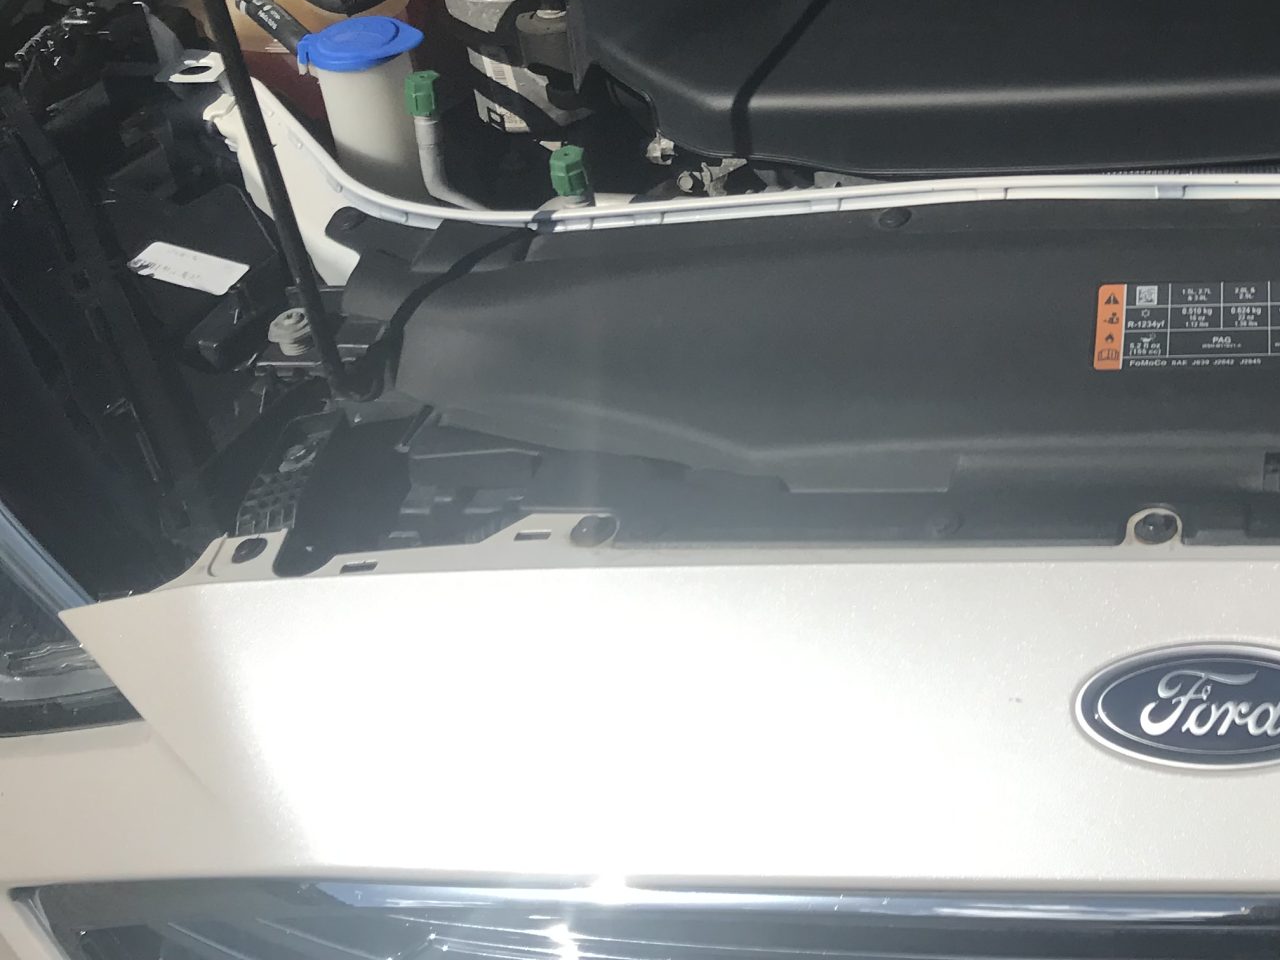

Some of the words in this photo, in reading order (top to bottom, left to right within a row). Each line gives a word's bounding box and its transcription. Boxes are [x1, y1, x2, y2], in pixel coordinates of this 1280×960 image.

[1203, 307, 1213, 317] kg
[1251, 306, 1262, 316] kg
[1127, 320, 1166, 329] R-1234yf
[1212, 336, 1232, 344] PAG
[1129, 359, 1168, 367] FoMoCo
